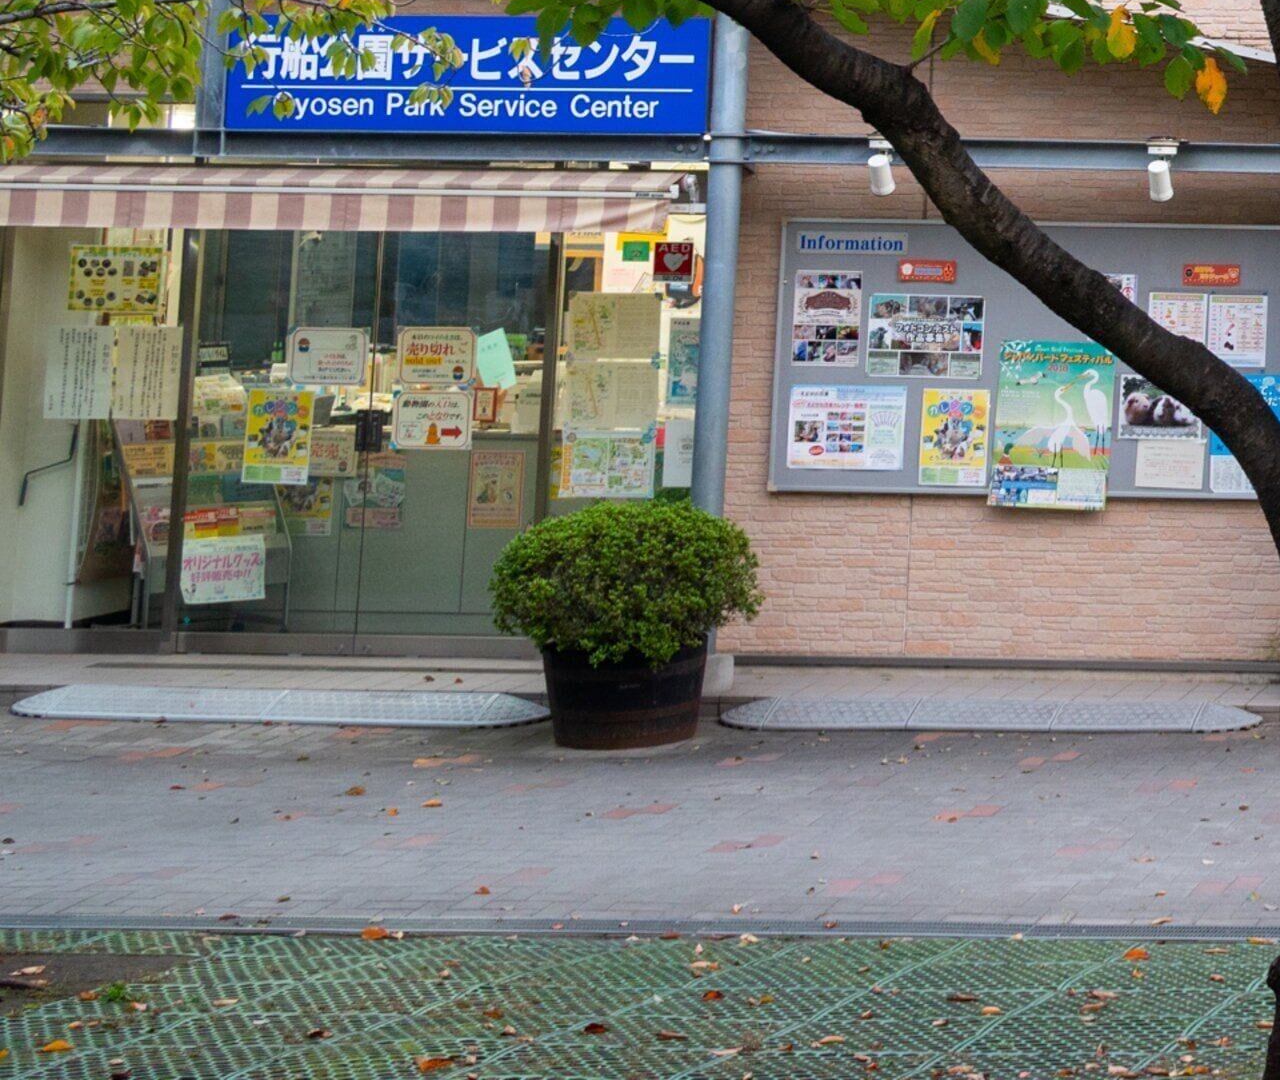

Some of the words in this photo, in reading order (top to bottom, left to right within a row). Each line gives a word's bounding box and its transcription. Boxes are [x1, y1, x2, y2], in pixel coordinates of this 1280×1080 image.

[245, 33, 696, 82] 行船公園サビスセンター
[386, 93, 445, 117] Park
[459, 93, 558, 118] Service
[570, 94, 660, 119] Center
[658, 243, 691, 253] AED
[800, 234, 904, 252] Information
